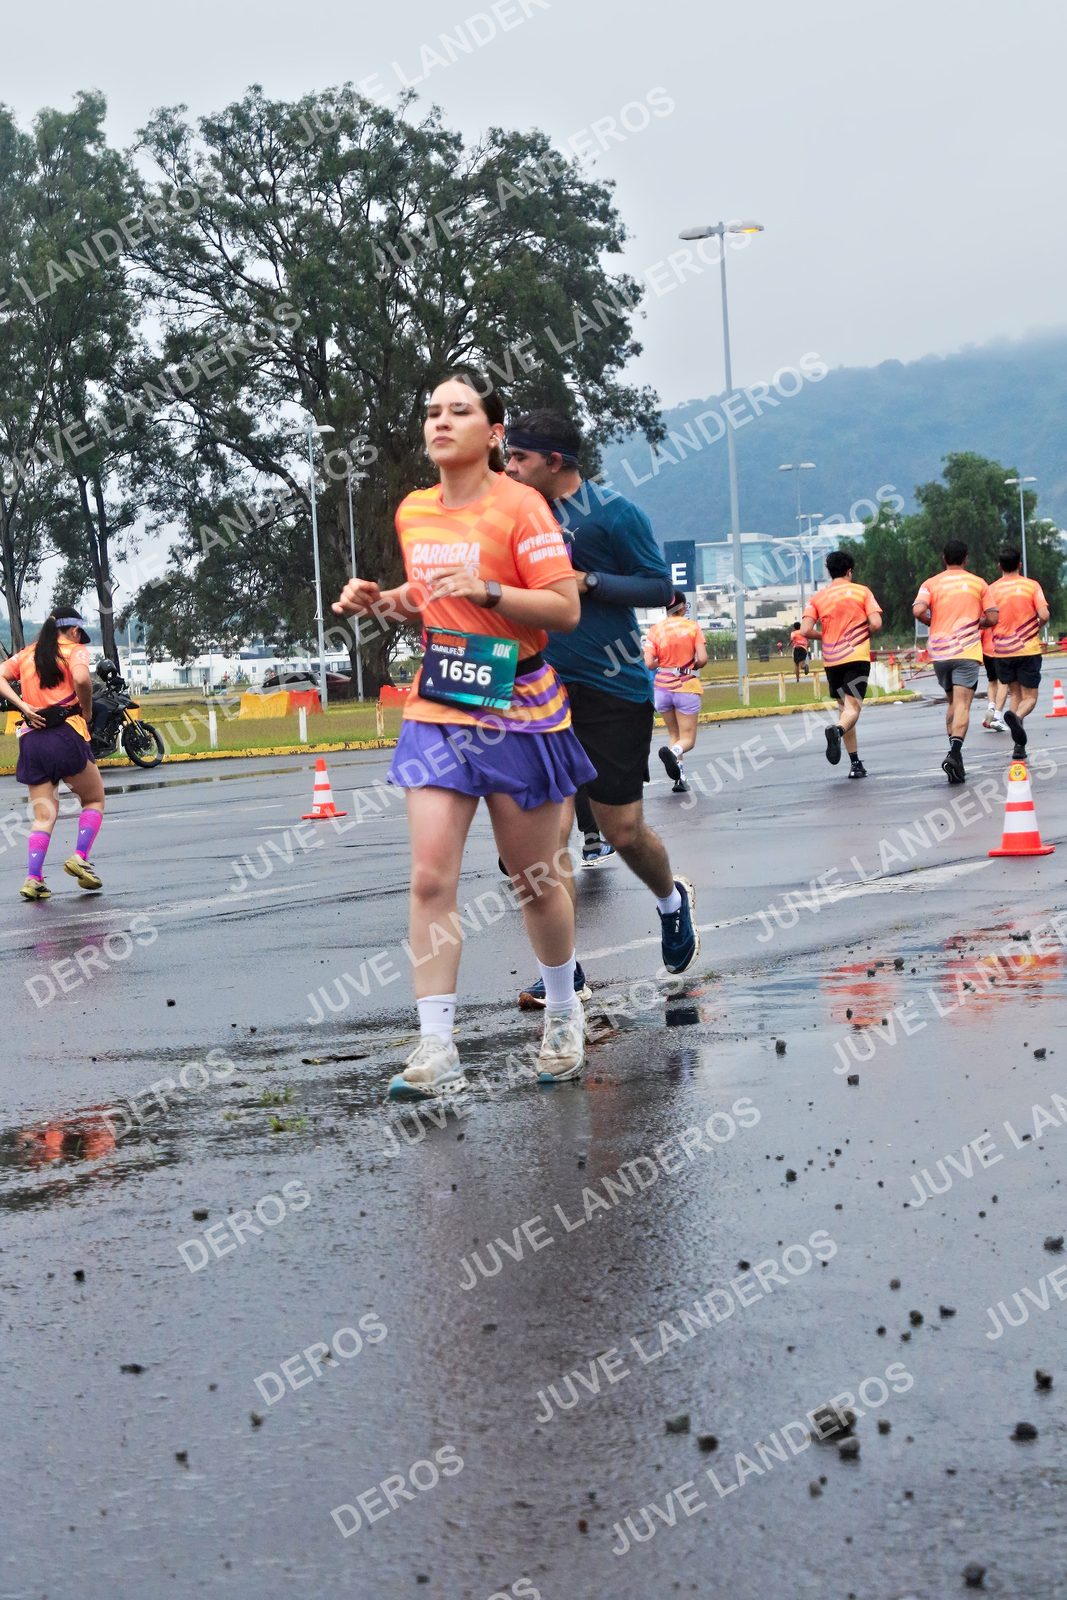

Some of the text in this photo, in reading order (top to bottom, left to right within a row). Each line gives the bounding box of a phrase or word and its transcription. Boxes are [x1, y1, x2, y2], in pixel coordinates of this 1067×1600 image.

[411, 542, 480, 565] CARRERA
[671, 562, 688, 586] E
[492, 643, 512, 659] 10K
[439, 658, 493, 686] 1656
